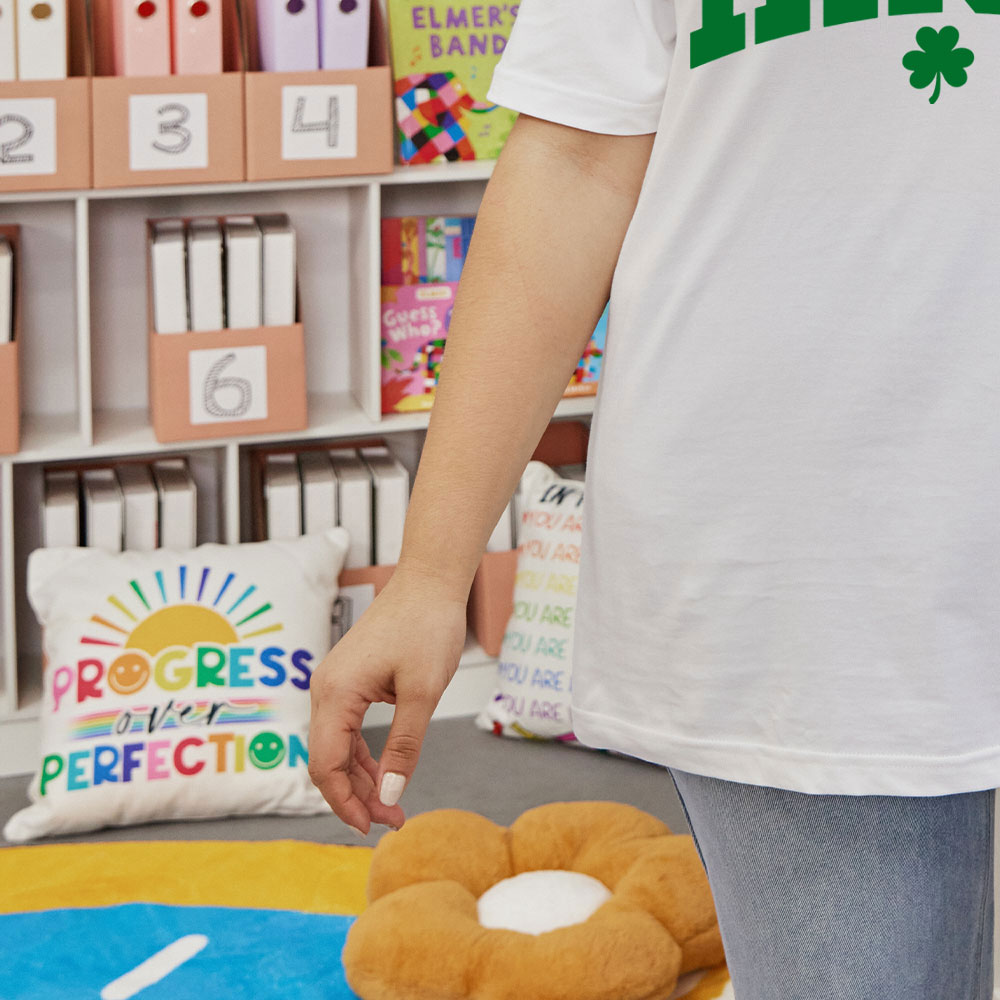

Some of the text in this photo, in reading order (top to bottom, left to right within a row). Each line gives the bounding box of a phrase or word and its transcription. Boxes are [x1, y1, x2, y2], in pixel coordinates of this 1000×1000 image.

[429, 34, 509, 59] BAND
[152, 102, 192, 155] 3
[291, 96, 339, 148] 4
[382, 305, 438, 328] Guess
[387, 319, 443, 343] Who?
[204, 352, 252, 419] 6
[540, 603, 573, 629] ARE
[535, 635, 567, 660] ARE
[52, 646, 314, 712] PROGRESS
[531, 666, 564, 692] ARE
[116, 698, 258, 735] over
[39, 731, 308, 797] PERFECTION
